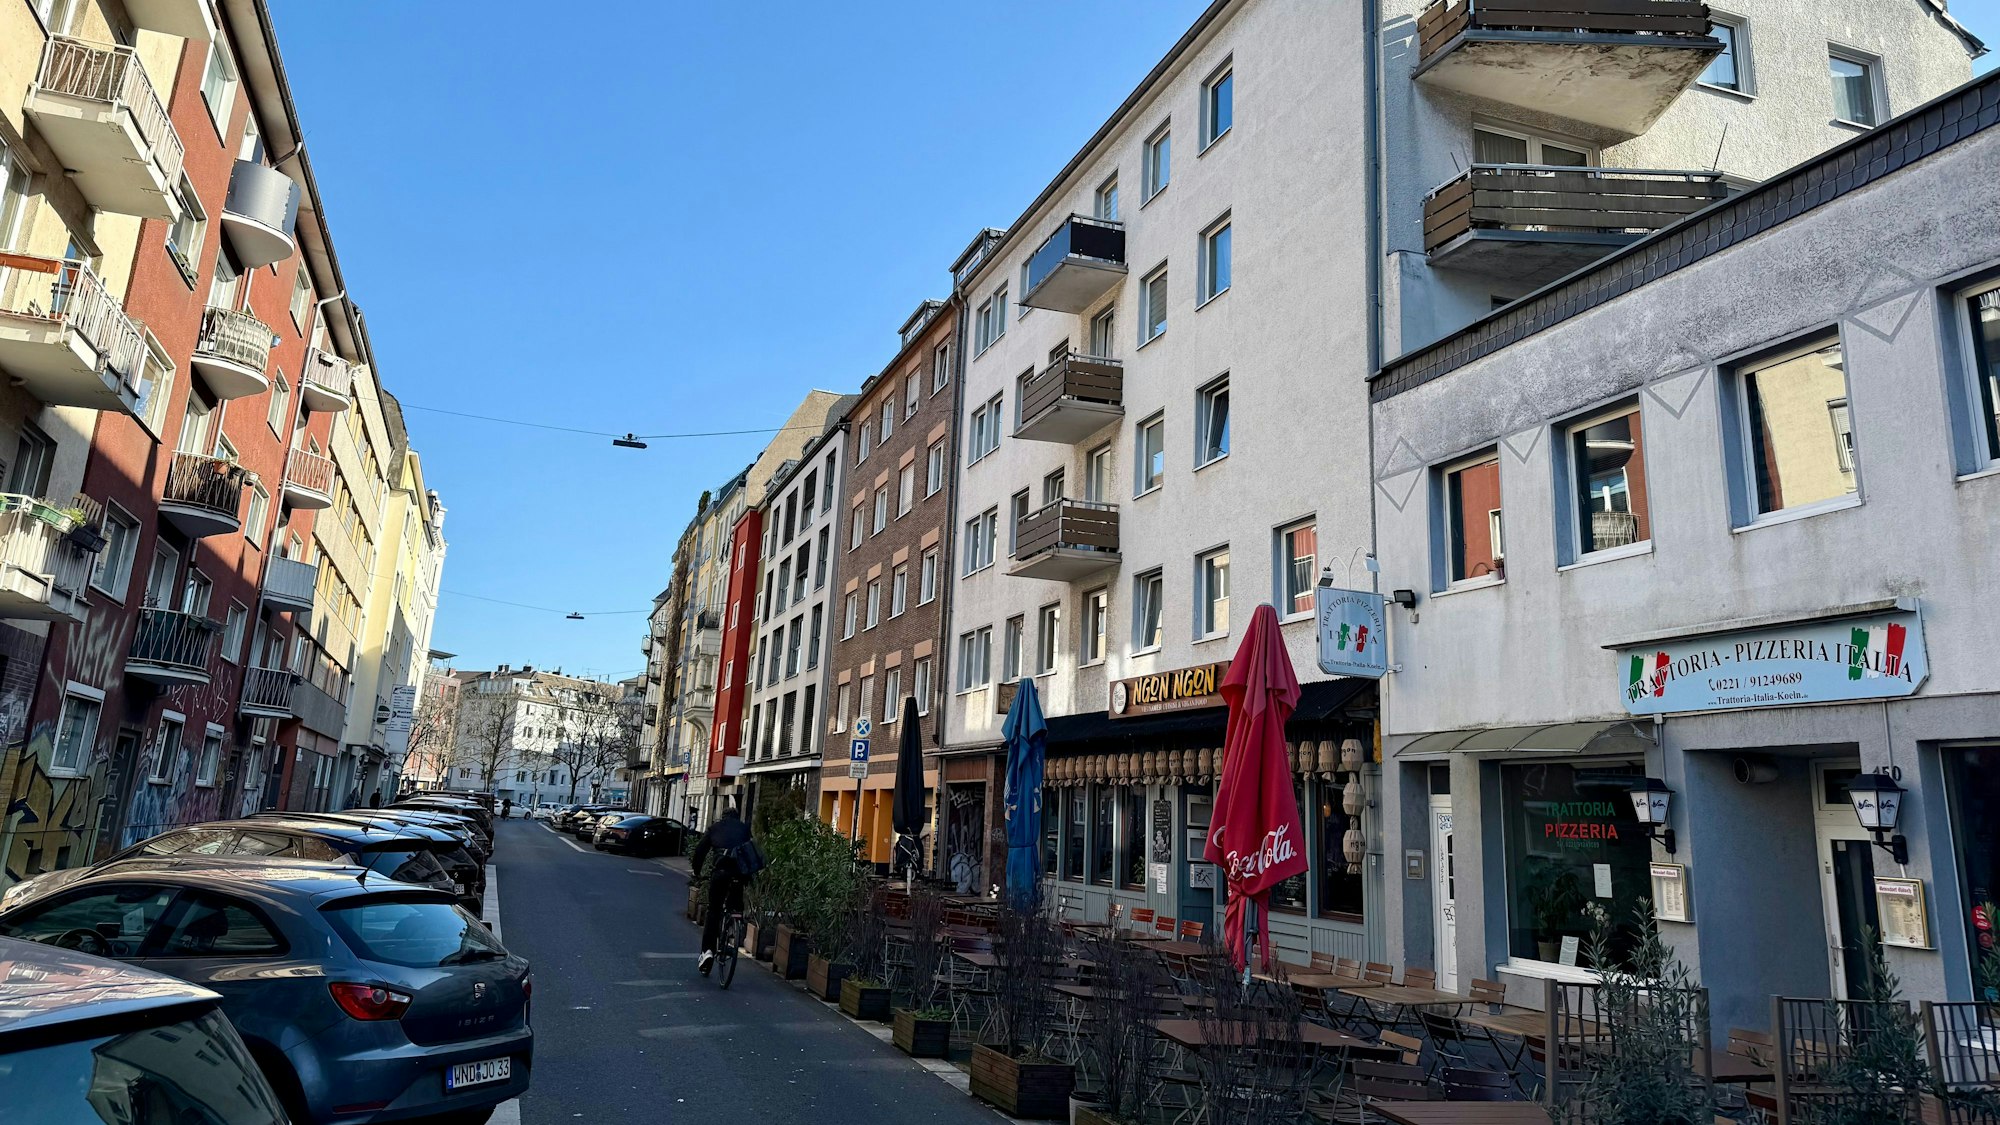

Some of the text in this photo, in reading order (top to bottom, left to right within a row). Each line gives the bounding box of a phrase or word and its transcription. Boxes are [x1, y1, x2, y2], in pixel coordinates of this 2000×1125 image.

[1323, 596, 1382, 634] TRATTORIA PIZZERIA
[1329, 630, 1378, 645] ITALIA
[1626, 650, 1721, 704] TRATTORIA
[1735, 639, 1829, 663] PIZZERIA
[1835, 642, 1913, 683] ITALIA
[1716, 678, 1739, 690] 0221
[1750, 671, 1802, 687] 91249689
[1133, 672, 1169, 705] NGON
[1173, 664, 1215, 699] NGON
[855, 742, 865, 758] P
[1545, 801, 1616, 817] TRATTORIA
[1544, 823, 1618, 839] PIZZERIA
[454, 1058, 509, 1085] WND JO 33
